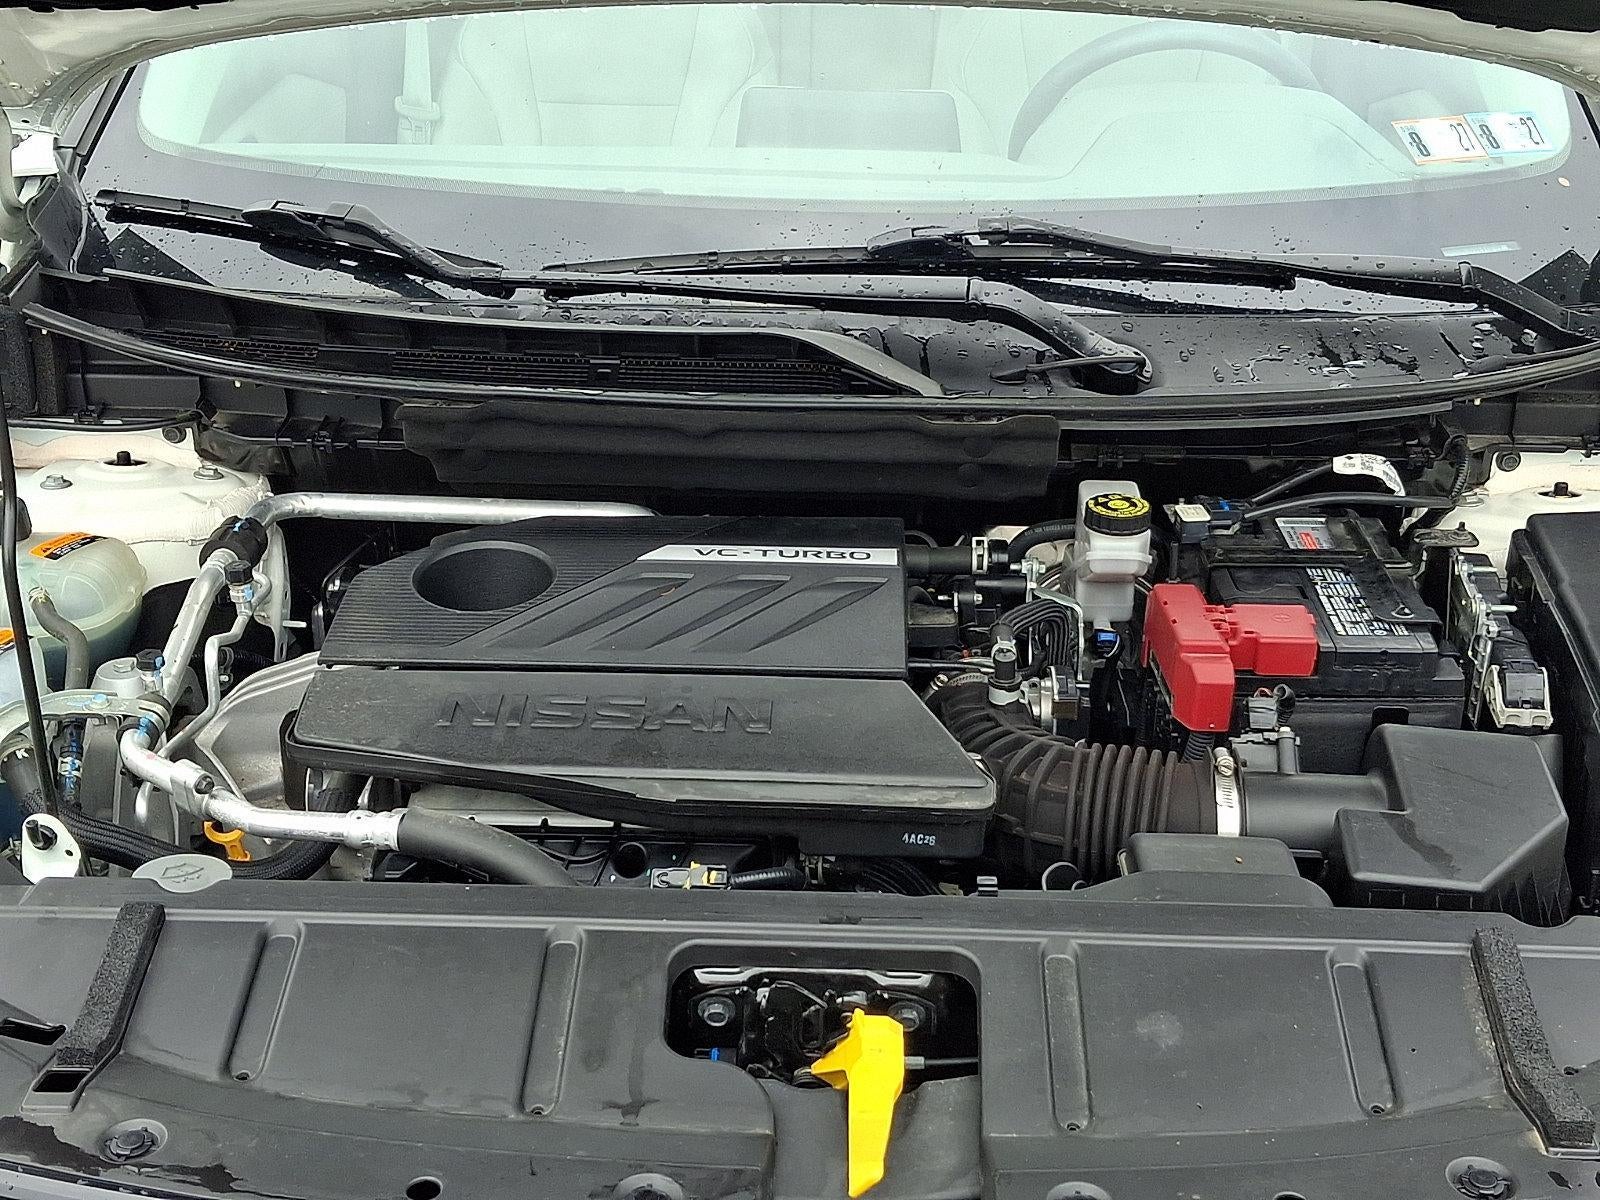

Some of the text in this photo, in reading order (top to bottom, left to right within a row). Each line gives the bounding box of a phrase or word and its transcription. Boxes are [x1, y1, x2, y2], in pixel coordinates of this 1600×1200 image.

[1408, 131, 1431, 157] 8
[1478, 123, 1500, 149] 8
[694, 548, 871, 561] VC-TURBO
[435, 694, 772, 735] NISSAN
